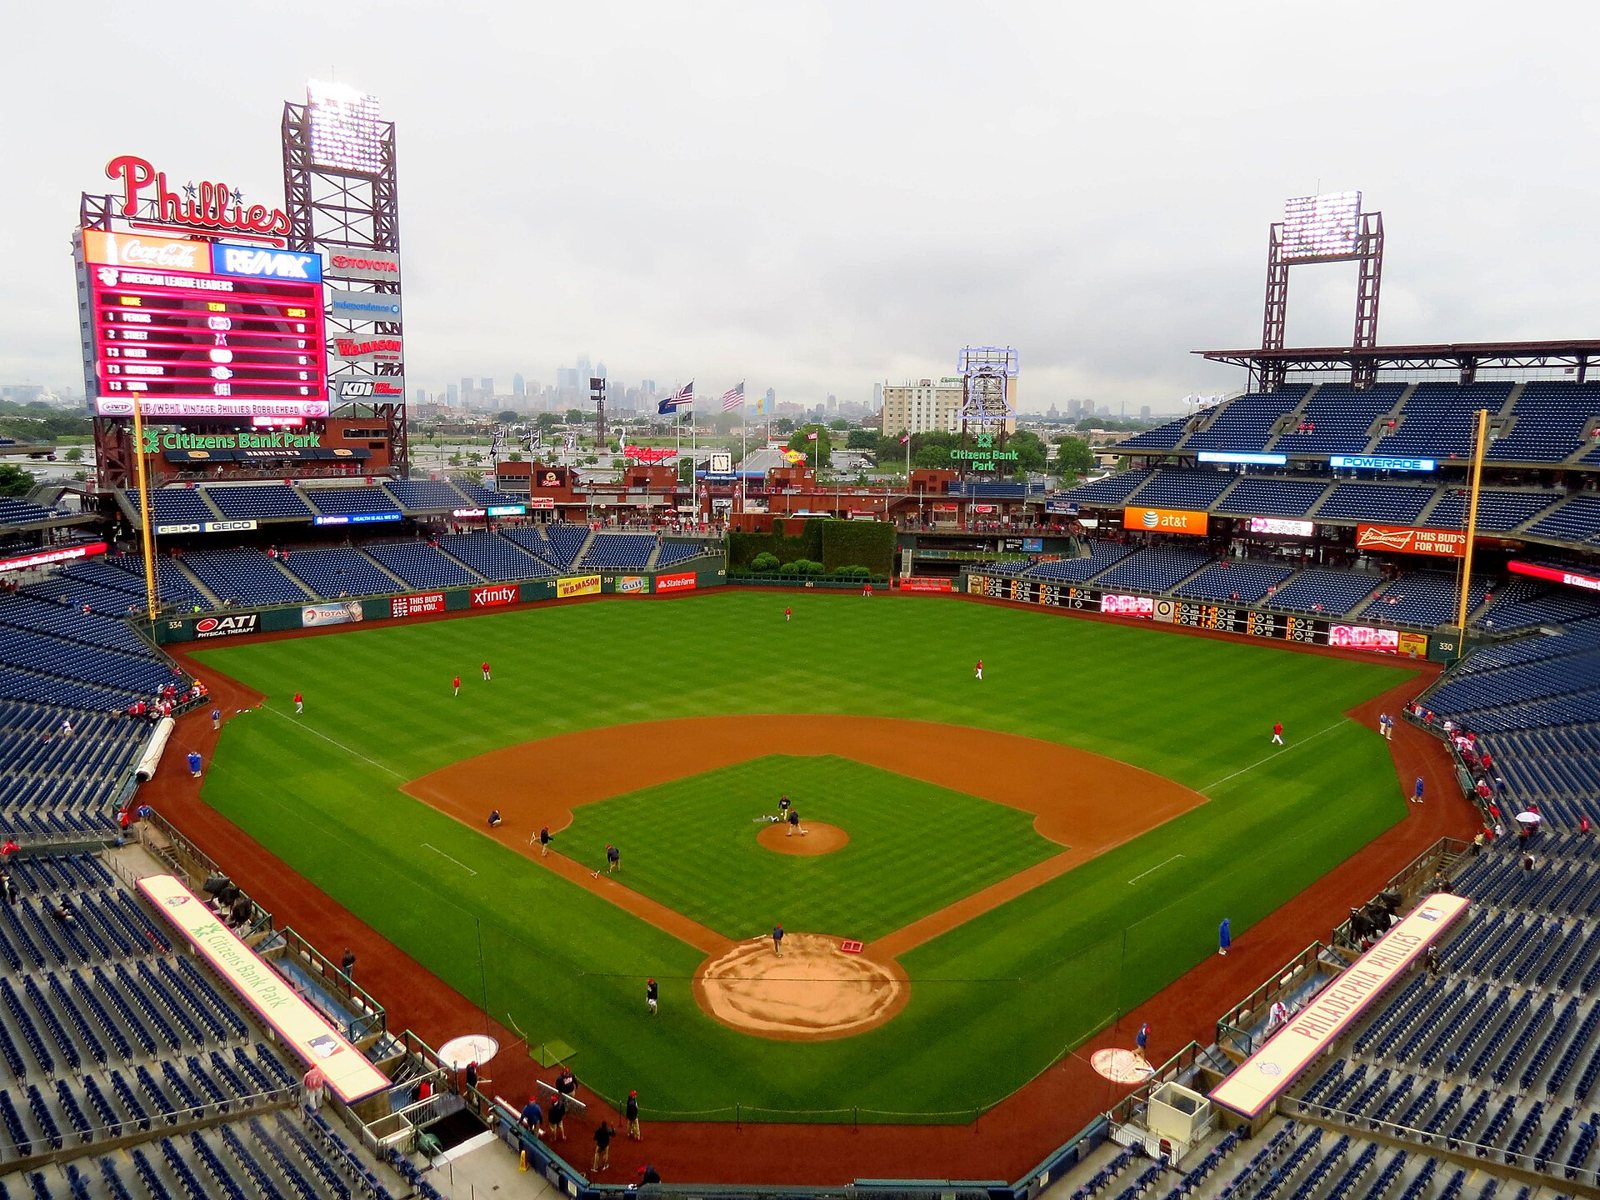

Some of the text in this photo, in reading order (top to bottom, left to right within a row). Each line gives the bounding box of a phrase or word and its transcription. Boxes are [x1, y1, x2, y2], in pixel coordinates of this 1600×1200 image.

[106, 155, 291, 236] Phillies
[225, 248, 308, 279] RE/MAX
[348, 257, 398, 272] TOYOTA
[121, 272, 233, 291] AMERICAN LEAGUE LEADERS
[107, 329, 115, 338] 2
[183, 404, 216, 414] VINTAGE
[217, 404, 250, 414] PHILLIES
[252, 404, 299, 415] BOBBLEHEAD
[162, 432, 321, 449] Citizens Bank Park
[950, 450, 1019, 460] Citizens Bank
[972, 461, 995, 471] Park
[1343, 457, 1422, 469] POWERADE
[1161, 513, 1187, 528] at&t
[158, 521, 251, 534] GEICO GEICO
[1360, 530, 1411, 543] Budweiser
[1415, 531, 1466, 544] THIS BUD'S
[1414, 542, 1455, 554] FOR YOU.
[621, 579, 643, 590] Gulf
[409, 594, 443, 605] THIS BUD'S
[474, 587, 516, 605] xfinity
[318, 610, 348, 618] TOTAL
[409, 604, 422, 612] FOR
[217, 614, 257, 630] ATI
[227, 627, 254, 635] THERAPY
[1334, 626, 1389, 646] Phillies
[1439, 642, 1453, 651] 330
[208, 934, 288, 1009] Citizens Bank Park
[1292, 931, 1423, 1040] PHILADELPHIA PHILLIES
